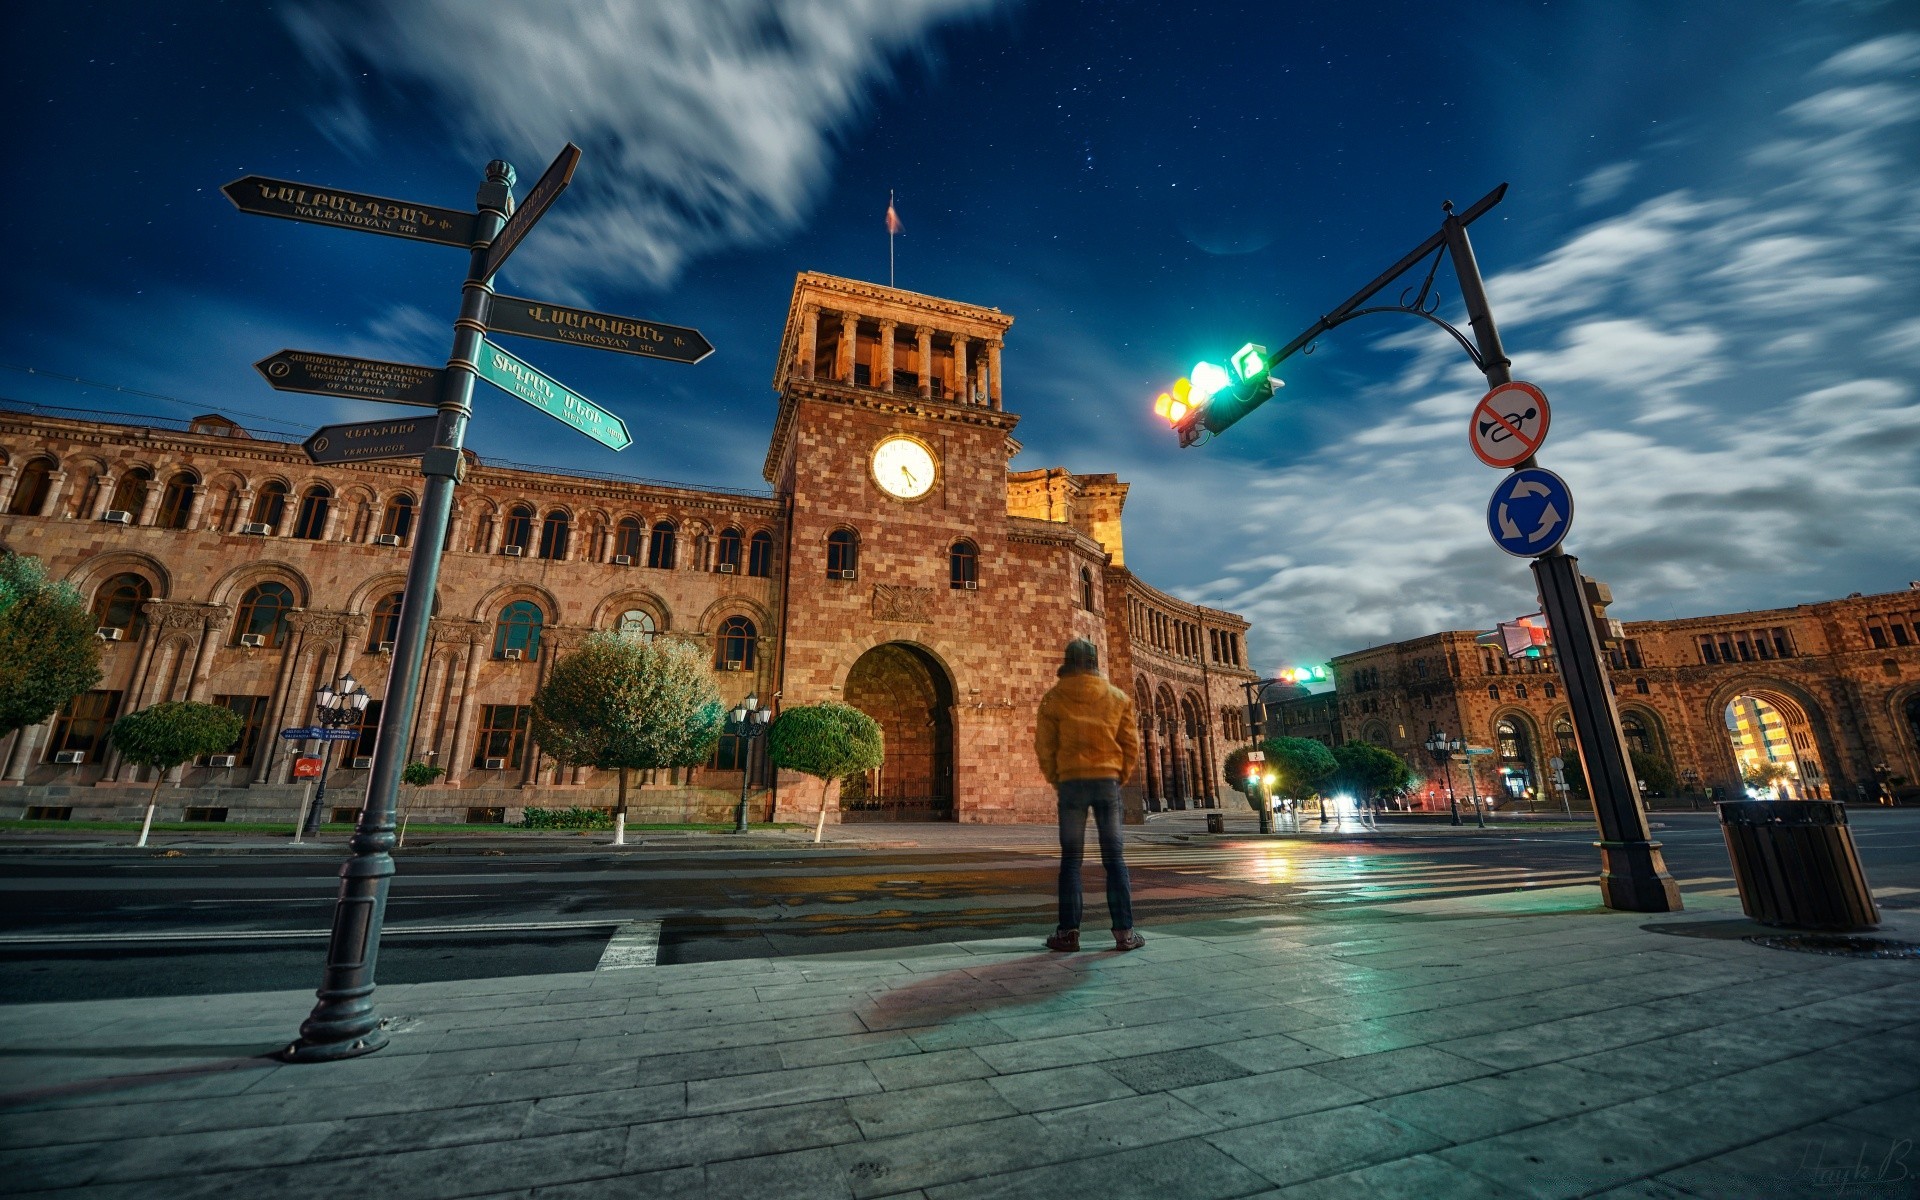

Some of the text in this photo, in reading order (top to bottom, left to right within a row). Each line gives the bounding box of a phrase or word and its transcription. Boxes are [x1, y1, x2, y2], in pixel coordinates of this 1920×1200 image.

[257, 183, 436, 227] ՆԱԼԲԱՆԴՅԱՆ
[294, 206, 391, 229] NALBANDYAN
[639, 342, 656, 353] str.
[309, 371, 349, 383] MUSEUM
[351, 376, 364, 386] OF
[365, 378, 390, 388] FOLK
[394, 382, 413, 391] ART
[326, 382, 386, 397] OF ARMENIA
[491, 353, 555, 400] ՏԻԳՐԱՆ
[563, 393, 603, 425] ՄԵԾԻ
[513, 381, 548, 407] TIGRAN
[561, 408, 585, 426] METS
